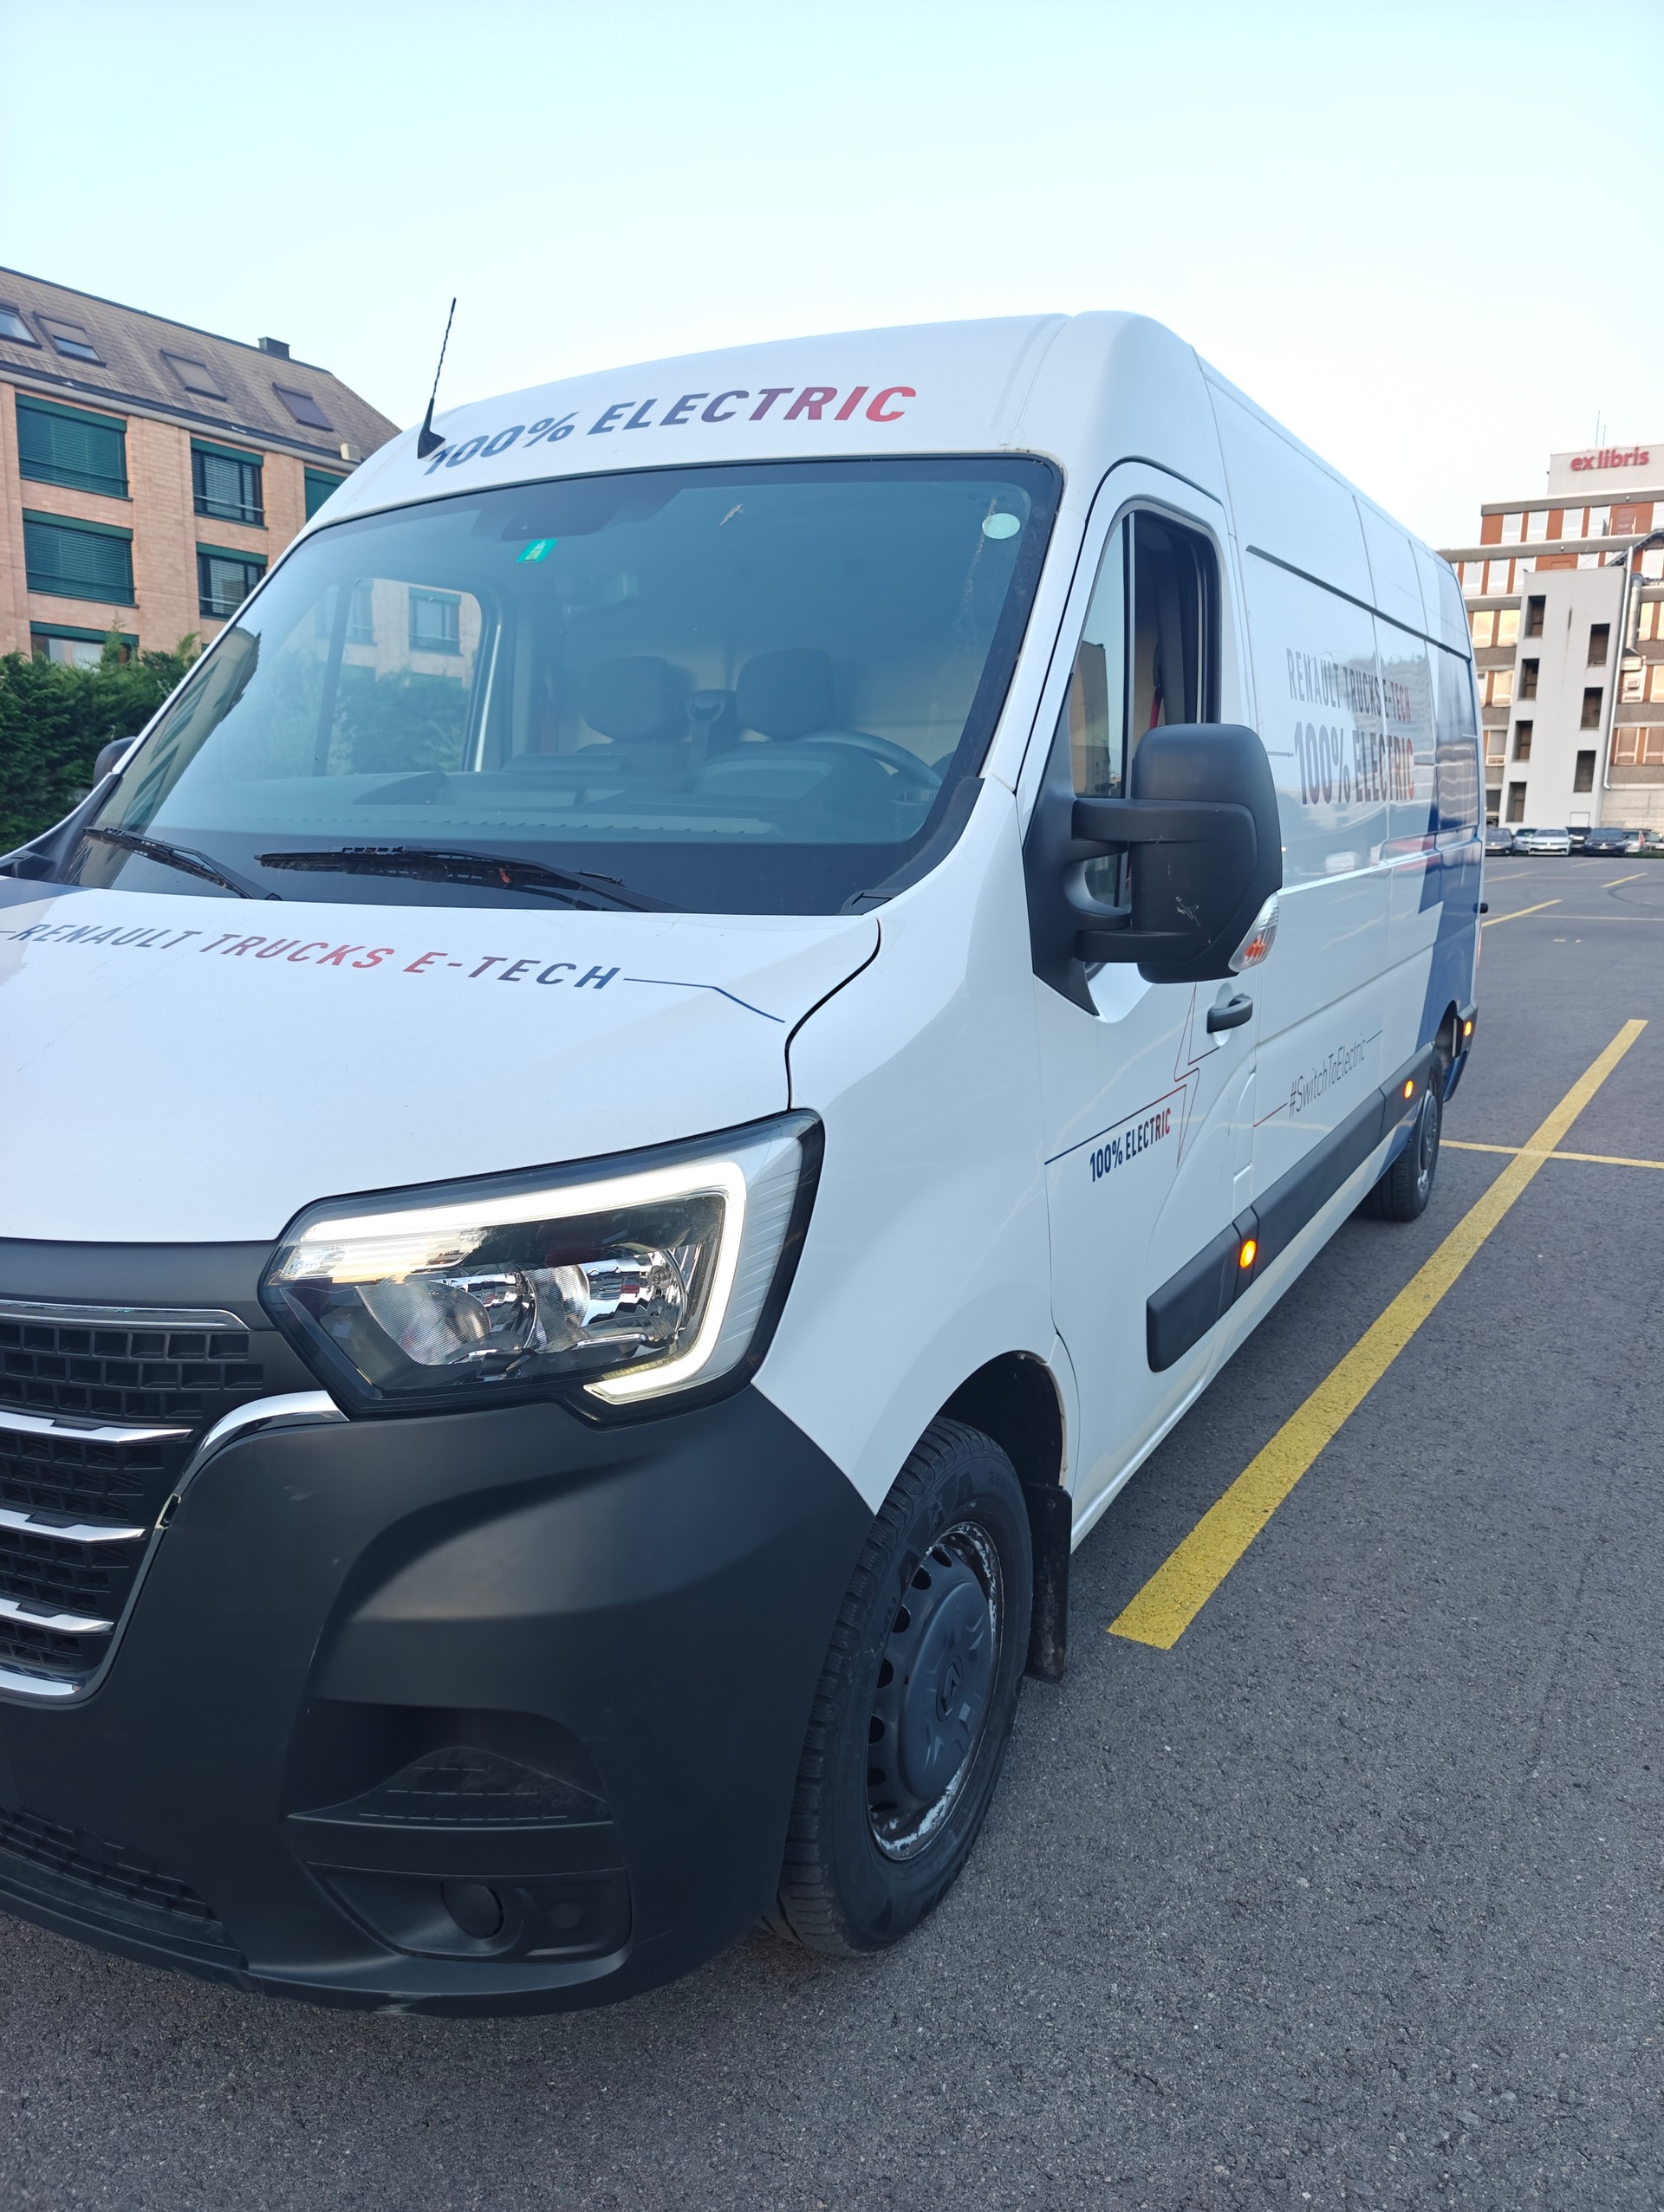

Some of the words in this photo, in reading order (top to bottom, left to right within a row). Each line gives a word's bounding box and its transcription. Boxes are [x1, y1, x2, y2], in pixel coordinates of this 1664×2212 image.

[423, 411, 581, 477] 100%
[587, 386, 917, 436] ELECTRIC
[1570, 456, 1595, 471] ex
[1597, 446, 1649, 469] libris
[1286, 648, 1341, 709] RENAULT
[1342, 666, 1381, 717] TRUCKS
[1294, 721, 1351, 805] 100%
[1352, 730, 1414, 802] ELECTRIC
[7, 924, 204, 950] RENAULT
[198, 933, 395, 969] TRUCKS
[402, 951, 621, 989] E-TECH
[1289, 1032, 1366, 1119] #SwitchToElectric
[1089, 1136, 1123, 1183] 100%
[1126, 1107, 1171, 1161] ELECTRIC
